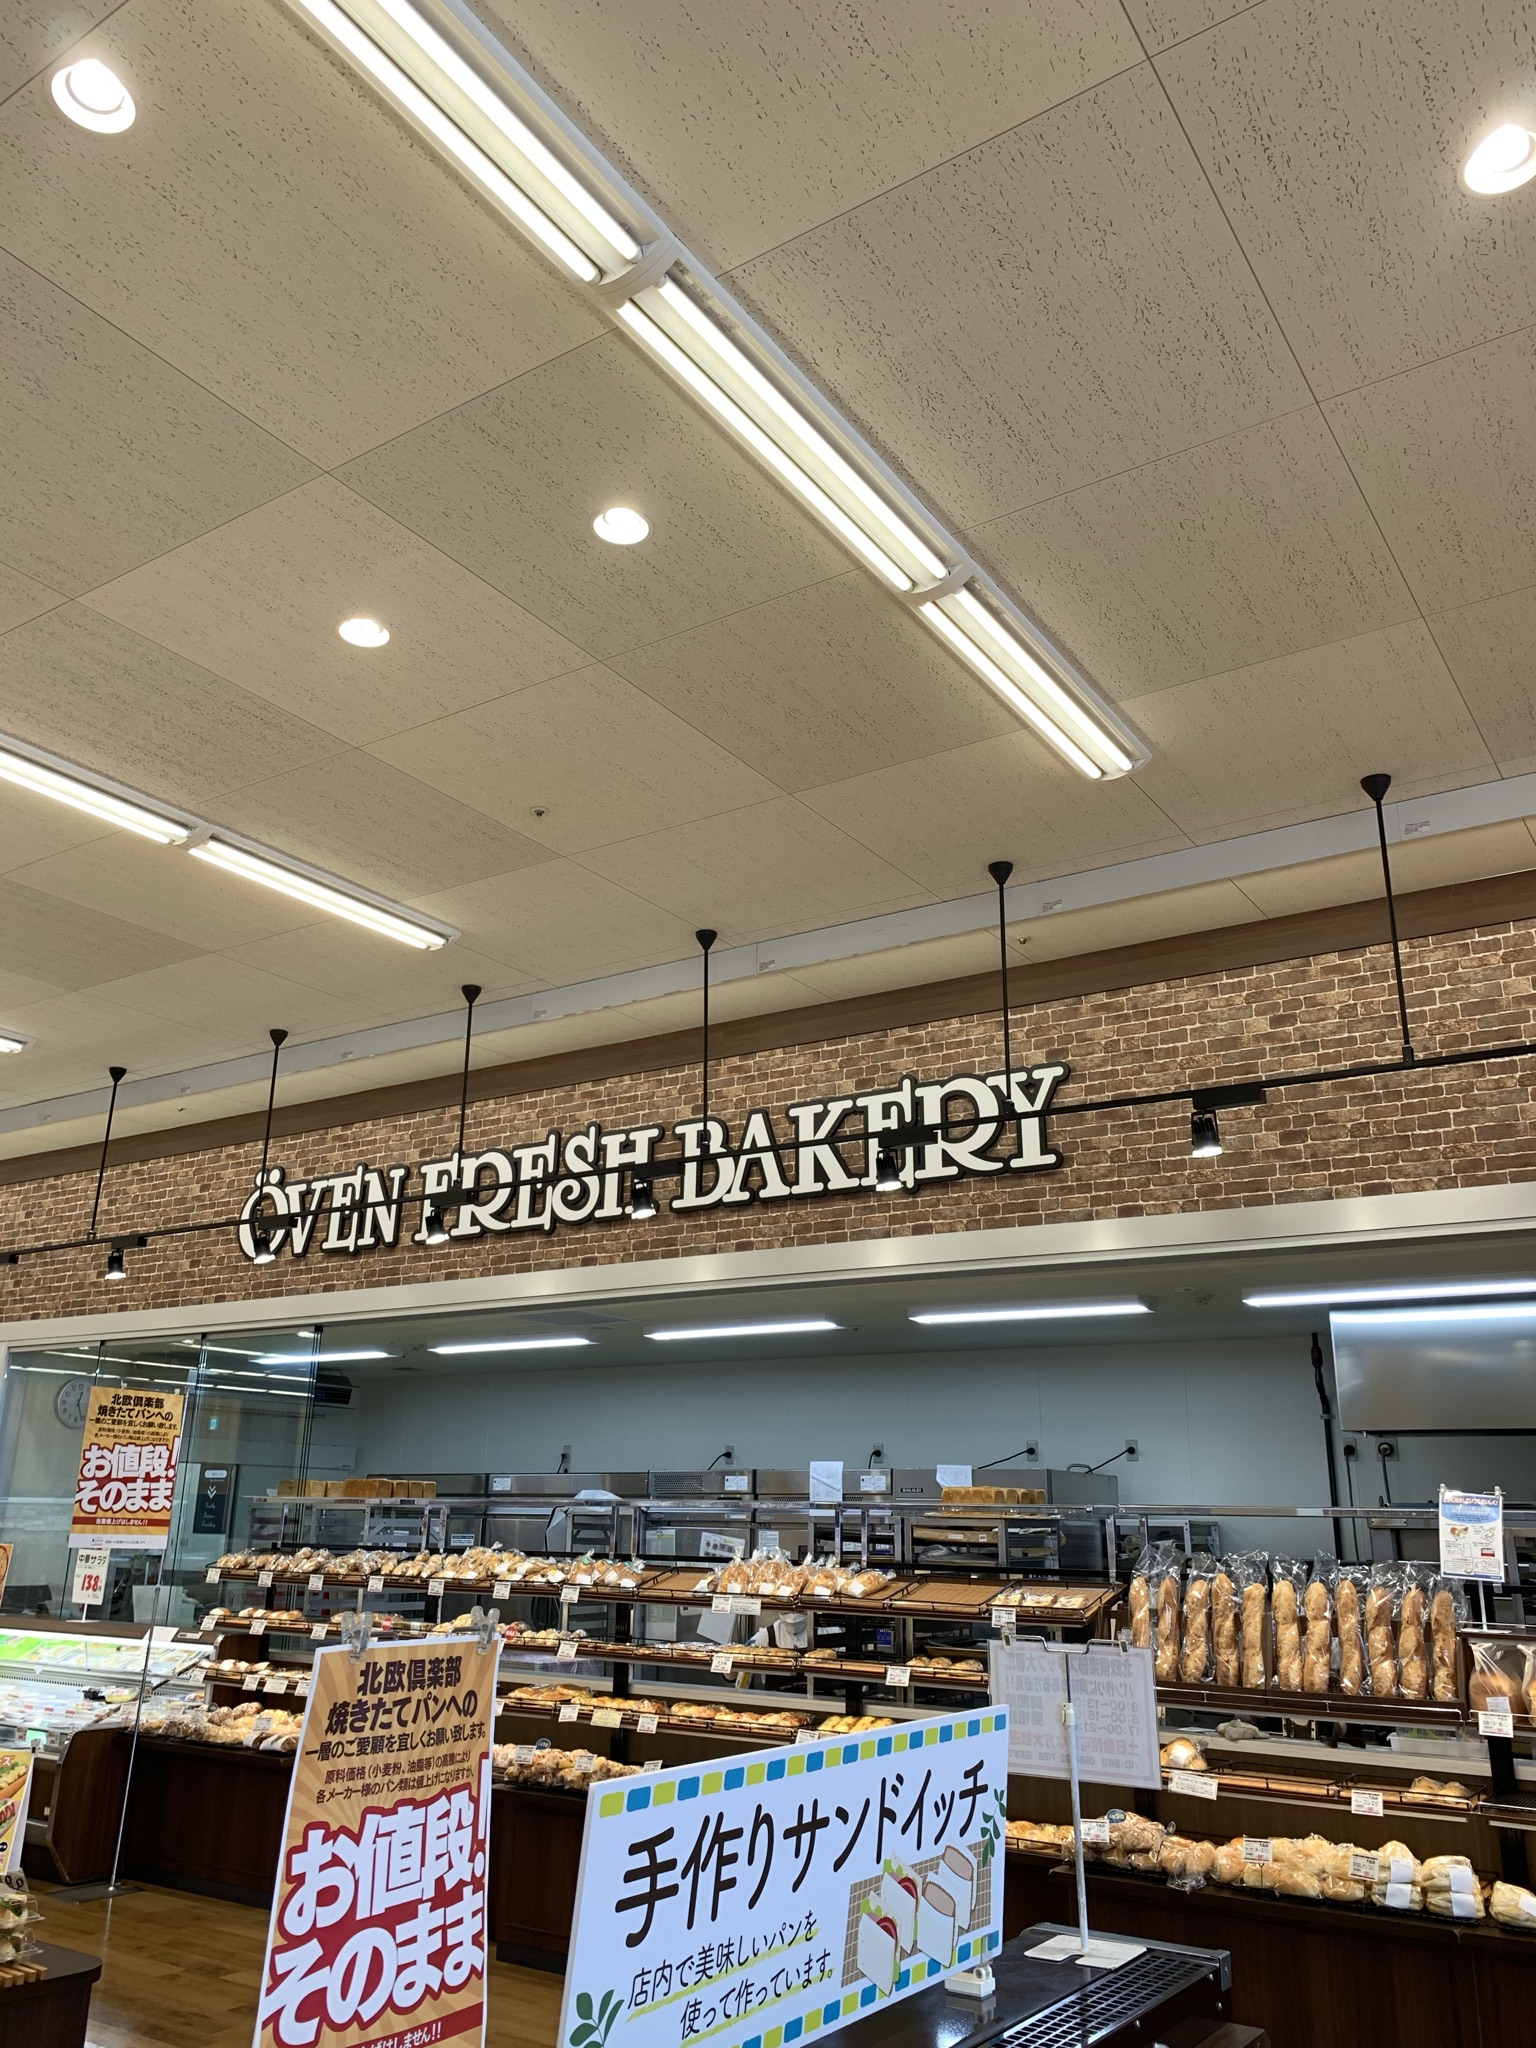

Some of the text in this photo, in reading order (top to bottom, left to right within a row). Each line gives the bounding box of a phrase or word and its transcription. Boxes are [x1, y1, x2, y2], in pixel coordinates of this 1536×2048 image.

[414, 1124, 664, 1244] FRESH
[671, 1064, 1068, 1209] BAKERY
[97, 1405, 174, 1422] 焼きたてパンへの
[75, 1478, 172, 1513] そのまま
[81, 1574, 100, 1592] 138
[356, 1655, 462, 1697] 北欧倶楽部
[325, 1690, 478, 1736] 焼きたてパンへの
[305, 1722, 486, 1762] 一層のご愛顧を宜しくお願い致します。
[614, 1758, 989, 1948] 手作りサンドイッチ
[258, 1885, 485, 2046] そのまま
[626, 1909, 818, 2010] 店内で美味しいパンを
[679, 1947, 833, 2041] 使って作っています。
